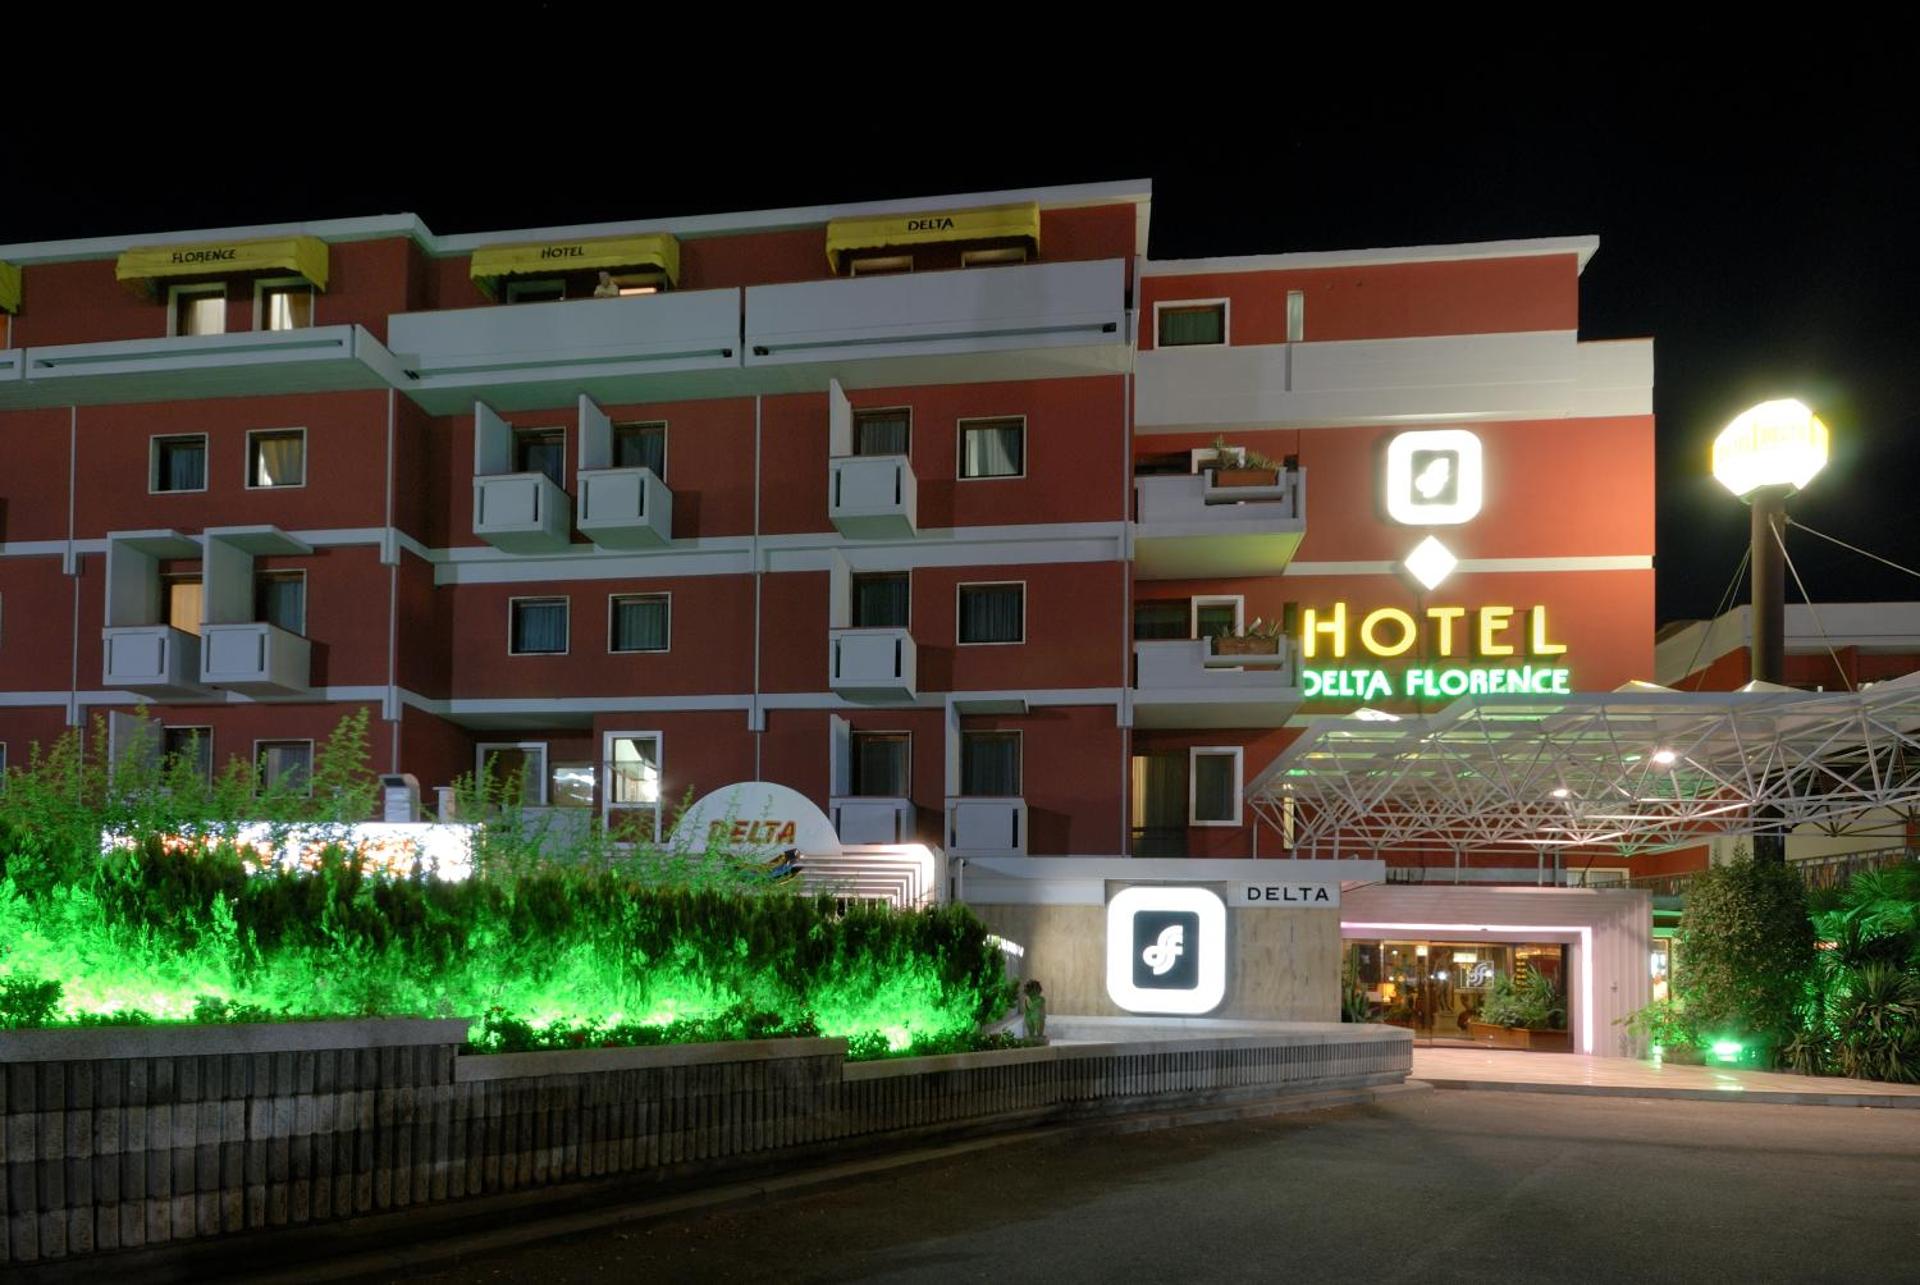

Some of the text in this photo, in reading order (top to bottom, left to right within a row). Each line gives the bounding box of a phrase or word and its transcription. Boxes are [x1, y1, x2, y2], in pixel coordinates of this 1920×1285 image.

[908, 217, 954, 231] DELTA
[172, 248, 237, 264] FLORENCE
[541, 245, 584, 259] HOTEL
[1303, 602, 1567, 658] HOTEL
[1303, 665, 1571, 700] DELTA FLORENCE
[1247, 886, 1330, 902] DELTA
